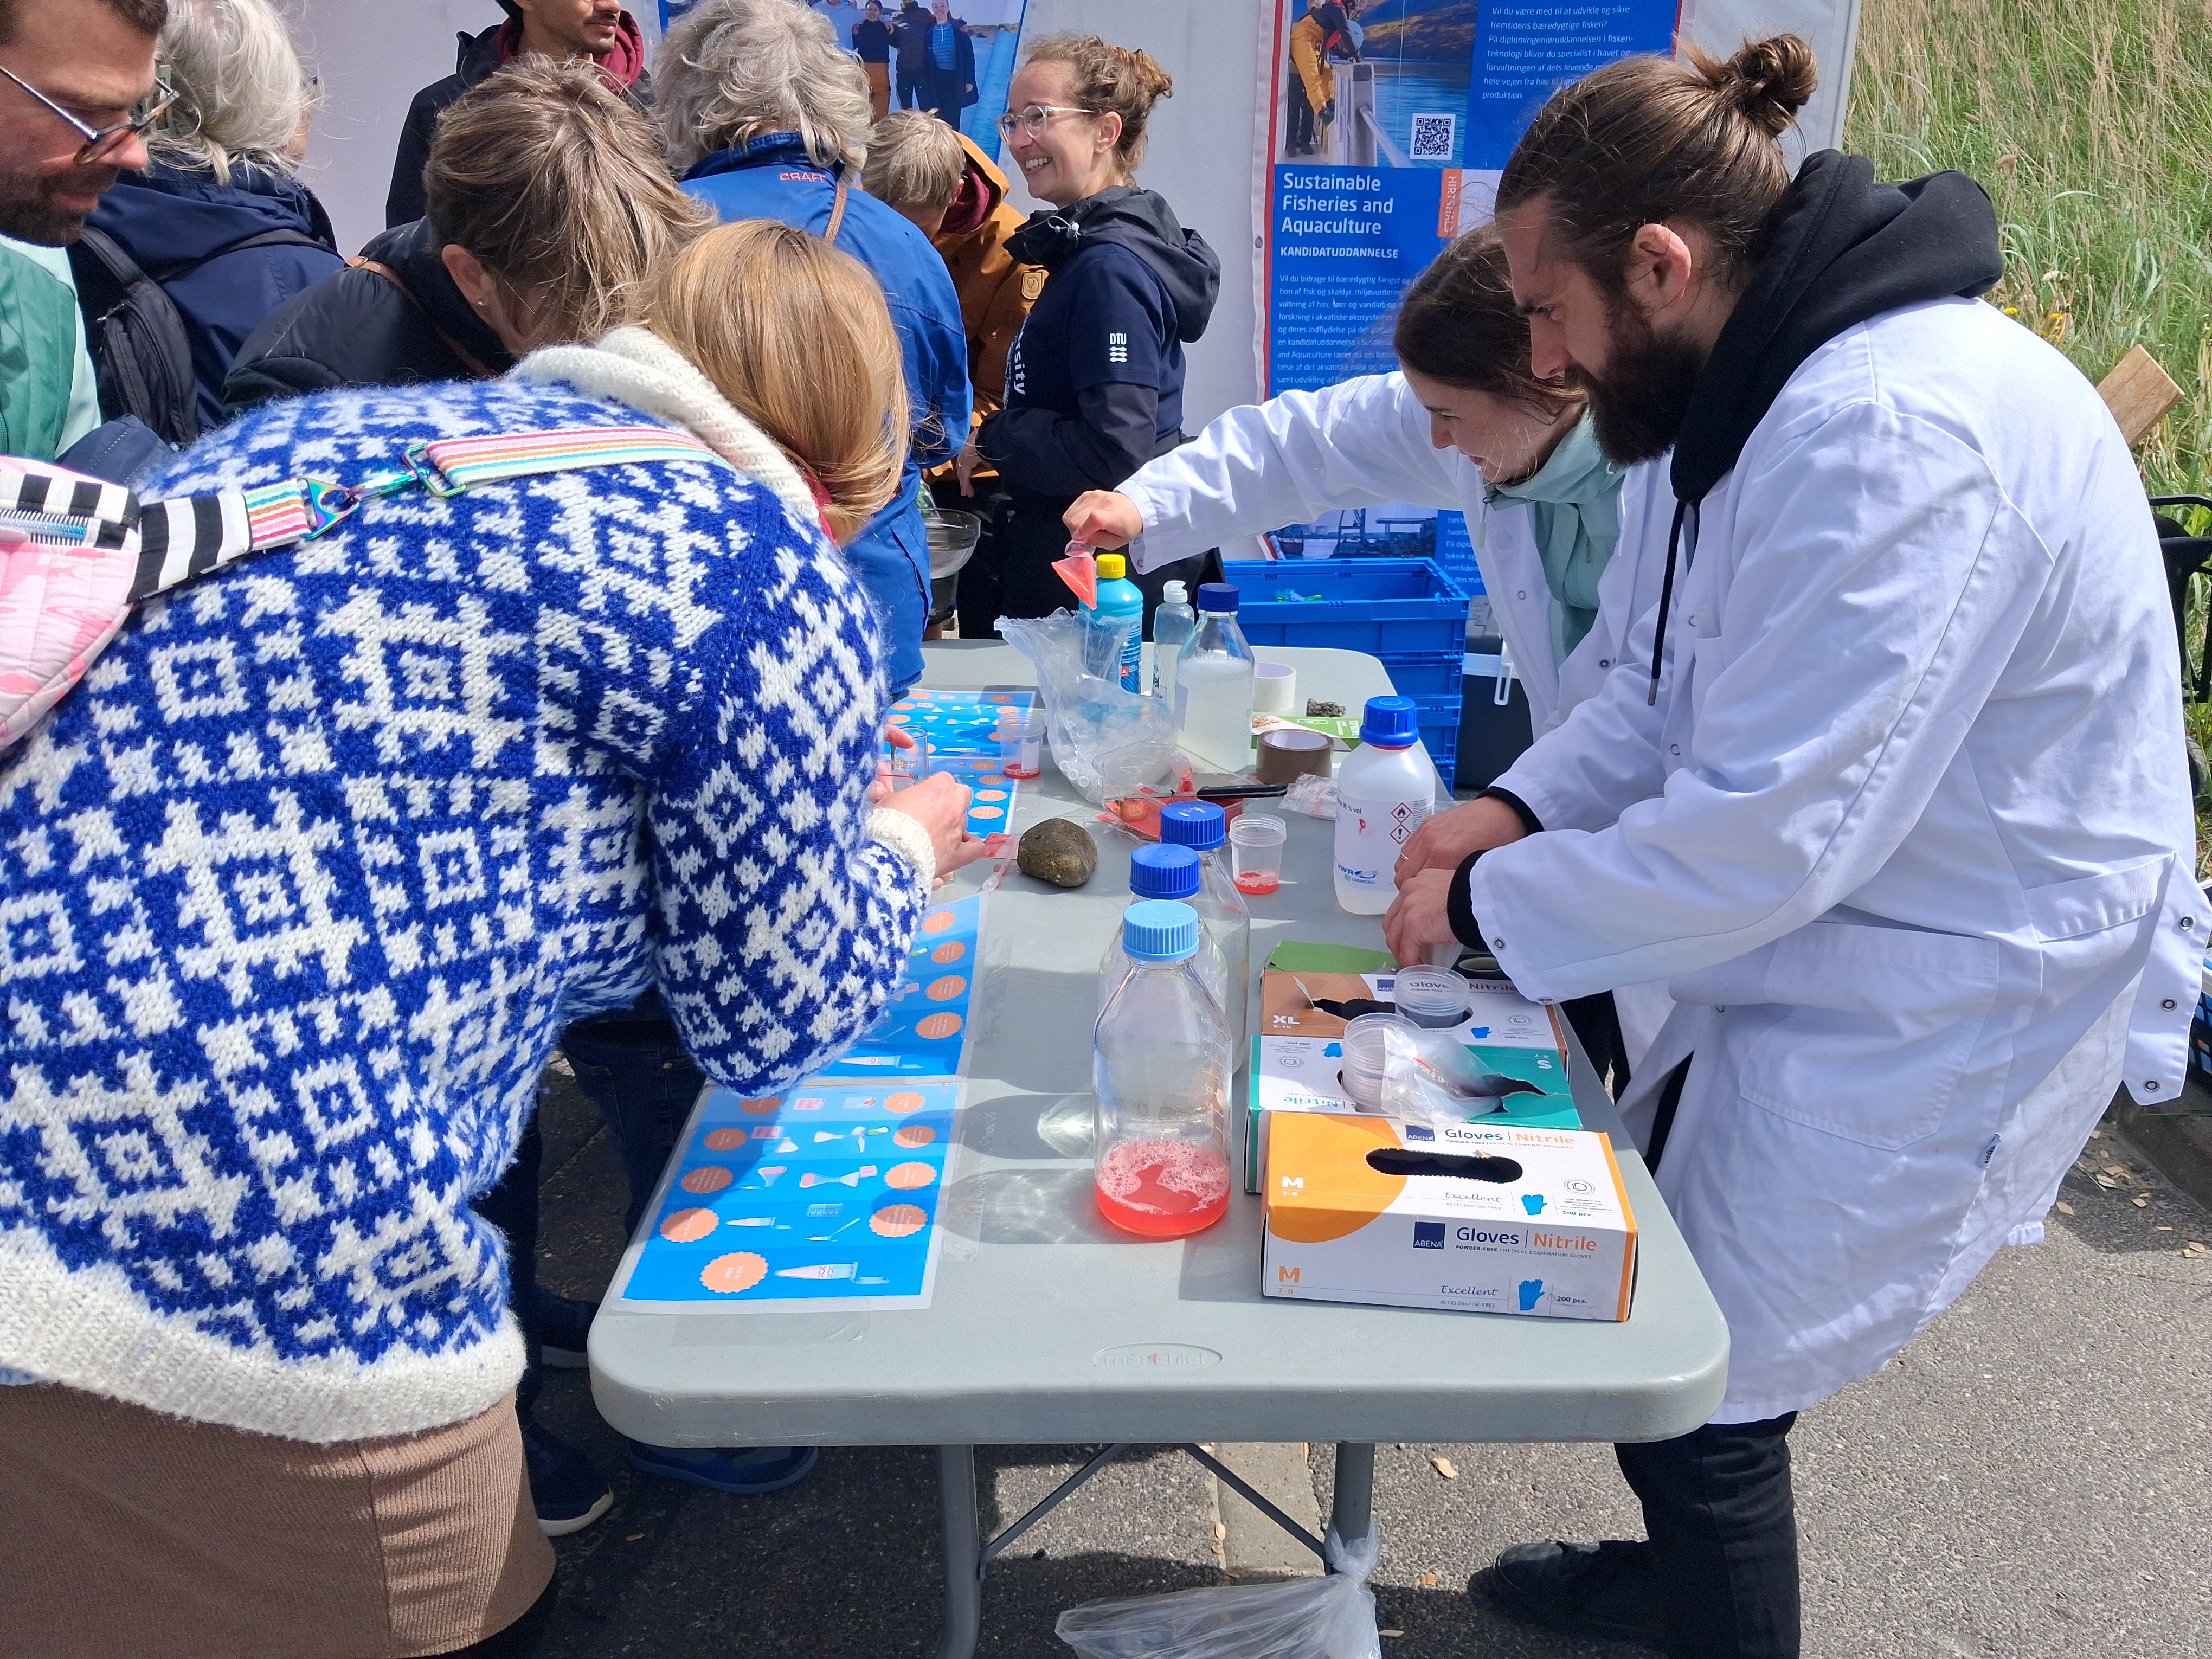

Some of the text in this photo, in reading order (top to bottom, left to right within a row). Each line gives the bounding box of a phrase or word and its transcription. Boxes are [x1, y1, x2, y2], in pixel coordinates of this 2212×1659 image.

[1536, 7, 1552, 15] med
[1491, 21, 1531, 29] fremtidens
[1533, 21, 1579, 31] bæredygtige
[1500, 35, 1600, 45] diplomingeniøruddannelsen
[1488, 50, 1522, 59] teknologi
[1558, 50, 1591, 58] specialist
[1486, 63, 1535, 73] forvaltningen
[1547, 63, 1561, 72] dets
[1502, 78, 1522, 86] vejen
[779, 172, 826, 184] CRAFT
[1284, 173, 1381, 191] Sustainable
[1283, 195, 1393, 214] Fisheries and
[1282, 217, 1381, 236] Aquaculture
[1281, 247, 1398, 259] KANDIDATUDDANNELSE
[1336, 276, 1376, 284] bæredygtig
[1378, 276, 1400, 285] fangst
[1279, 301, 1306, 309] valtning
[1278, 313, 1310, 322] forskning
[1309, 326, 1346, 335] indflydelse
[1348, 325, 1355, 335] på
[1109, 333, 1127, 345] DTU
[1291, 351, 1332, 360] Aquaculture
[1295, 376, 1325, 384] udvikling
[1338, 863, 1353, 875] VWR
[1273, 1015, 1300, 1025] XL
[1536, 1060, 1552, 1069] S
[1284, 1096, 1338, 1107] Nitrile
[1444, 1129, 1503, 1140] Gloves
[1516, 1133, 1574, 1144] Nitrile
[1282, 1176, 1303, 1189] M
[1444, 1192, 1502, 1203] Excellent
[1457, 1227, 1519, 1245] Gloves
[1534, 1233, 1597, 1251] Nitrile
[1278, 1266, 1300, 1283] M
[1441, 1285, 1499, 1296] Excellent
